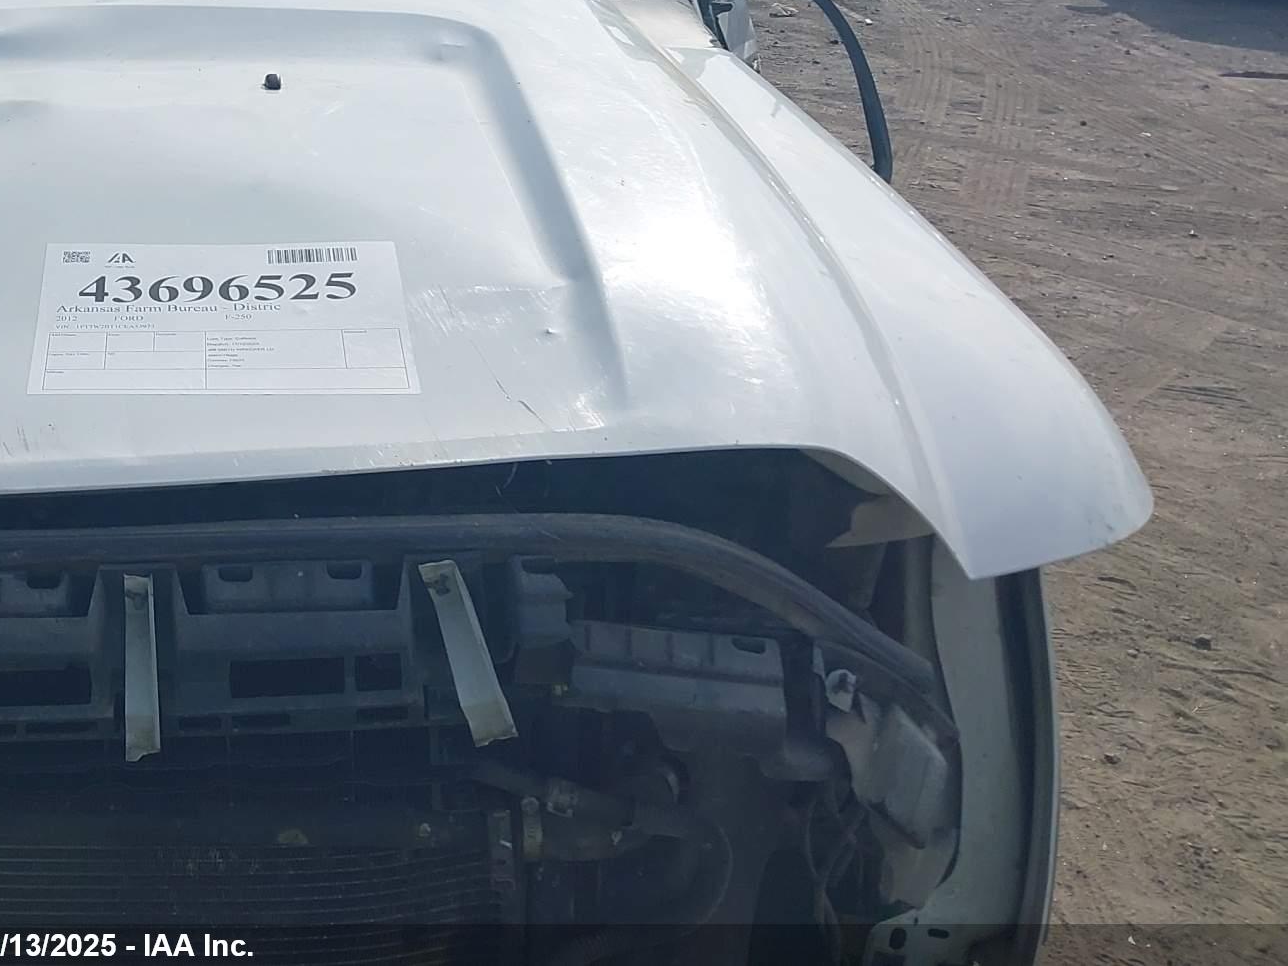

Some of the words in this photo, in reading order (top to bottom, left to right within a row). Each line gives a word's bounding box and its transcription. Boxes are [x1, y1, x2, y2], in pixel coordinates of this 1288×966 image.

[78, 272, 358, 303] 43696525
[56, 304, 121, 313] Arkansas
[126, 304, 162, 313] Farm
[167, 303, 218, 313] Bureau
[233, 302, 282, 312] Distric
[225, 313, 253, 321] F-250
